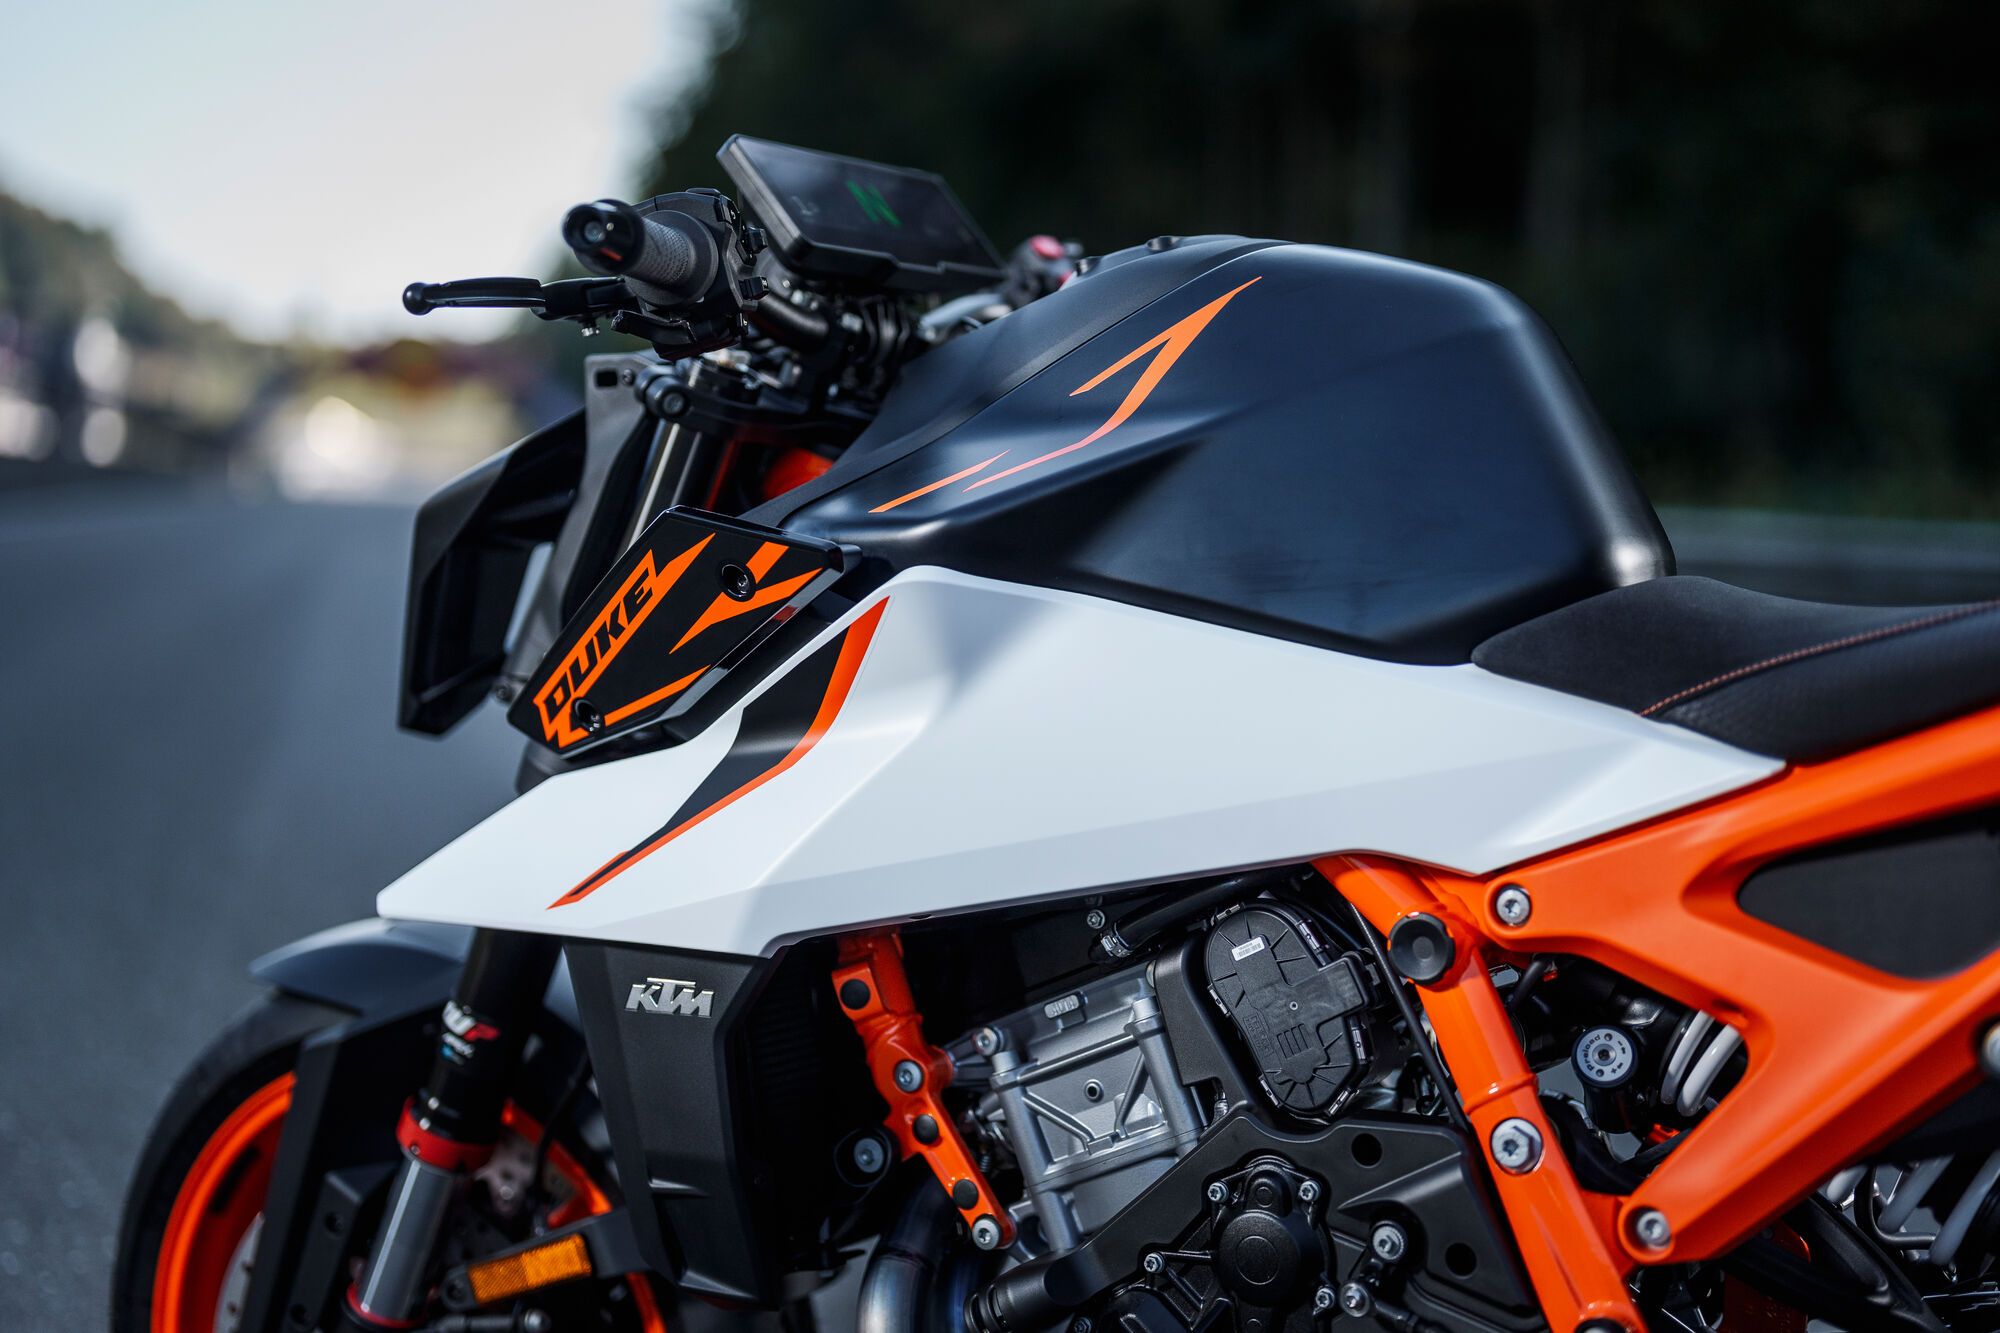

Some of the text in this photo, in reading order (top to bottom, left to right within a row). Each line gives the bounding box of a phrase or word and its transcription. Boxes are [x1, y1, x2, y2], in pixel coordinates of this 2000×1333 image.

[543, 567, 653, 724] DUKE
[624, 977, 714, 1018] KTM
[1583, 1034, 1600, 1071] Preload
